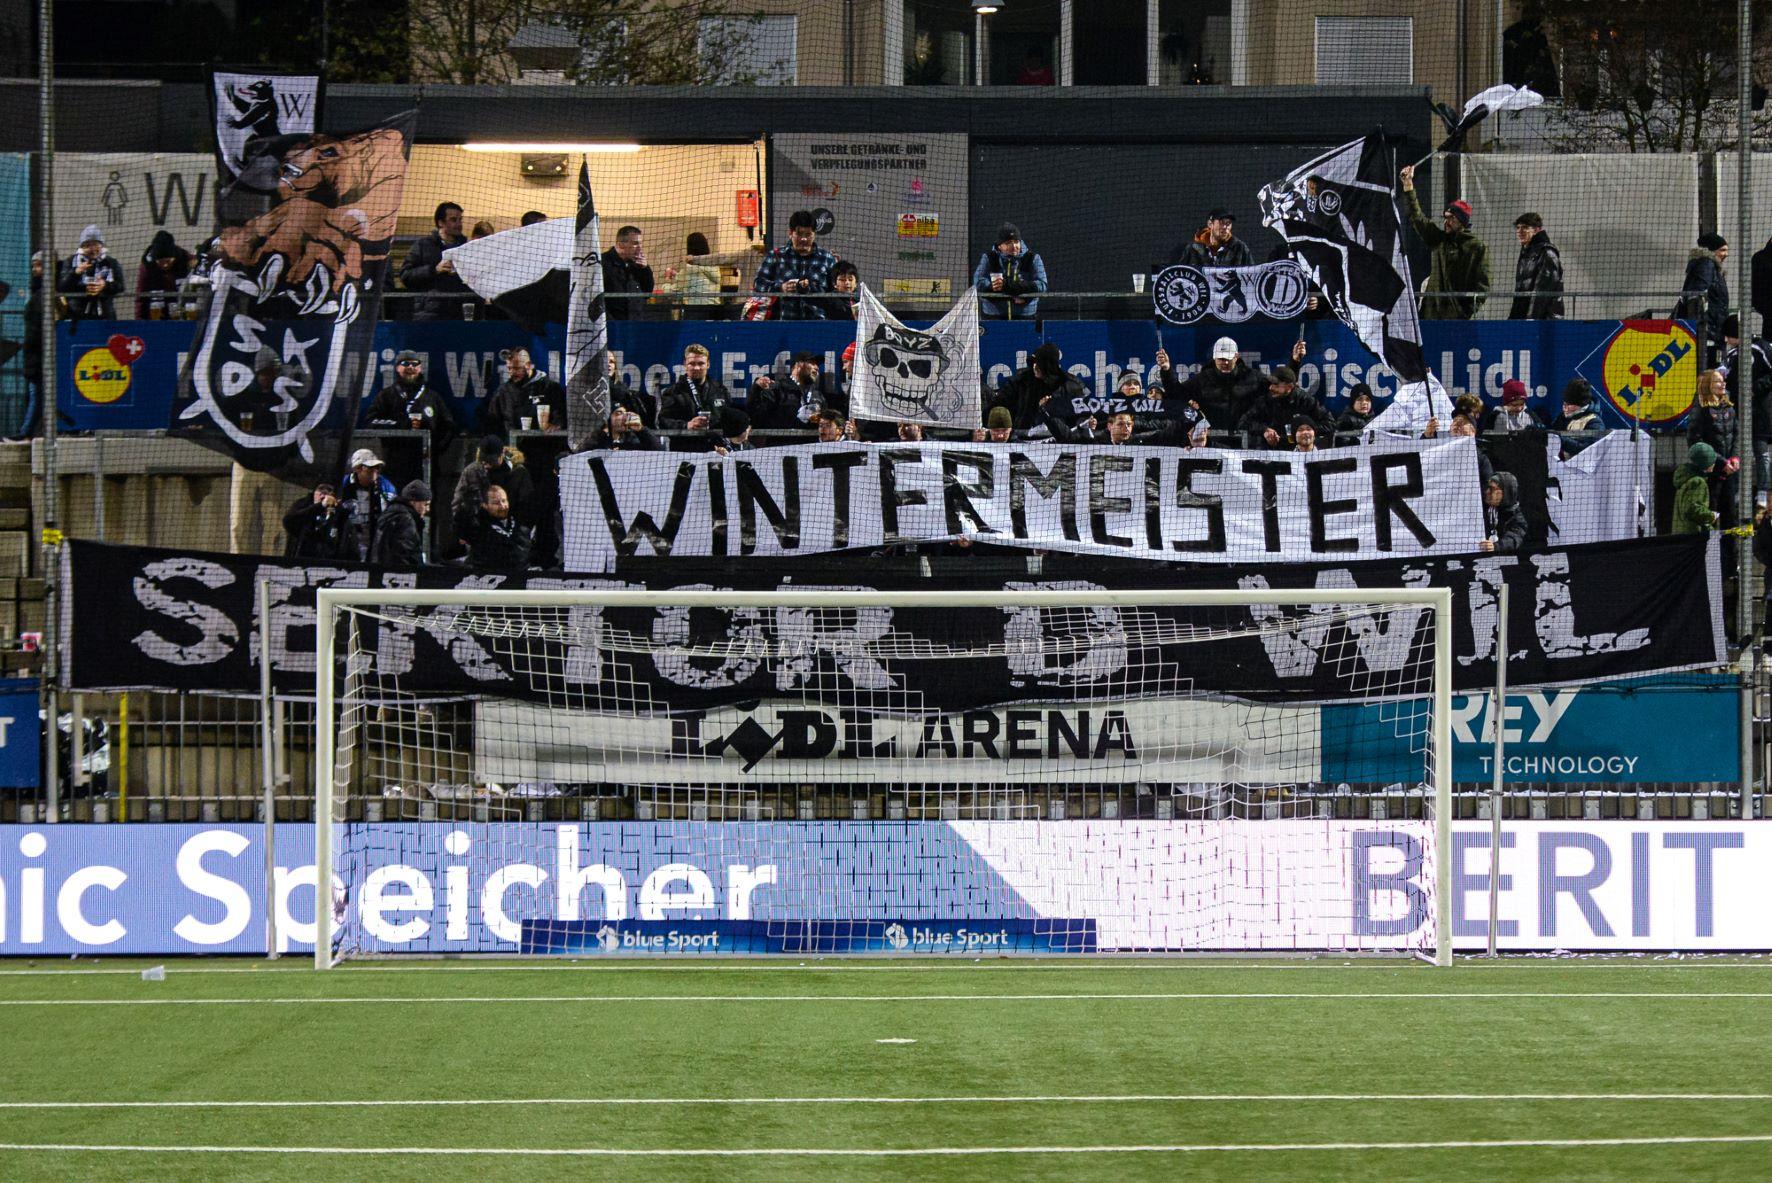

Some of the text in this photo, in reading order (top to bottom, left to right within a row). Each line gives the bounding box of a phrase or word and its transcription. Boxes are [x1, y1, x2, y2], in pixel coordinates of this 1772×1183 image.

[810, 144, 848, 155] UNSERE
[906, 144, 927, 155] UND
[811, 159, 927, 170] VERPFLEGUNGSPARTNER
[588, 448, 1437, 557] WINTERMEISTER
[915, 709, 1137, 760] ARENA
[1479, 755, 1639, 775] TECHNOLOGY
[172, 825, 777, 953] Speicher
[1351, 830, 1746, 938] BERIT
[623, 929, 720, 949] blue Sport
[912, 927, 1008, 949] blue Sport
